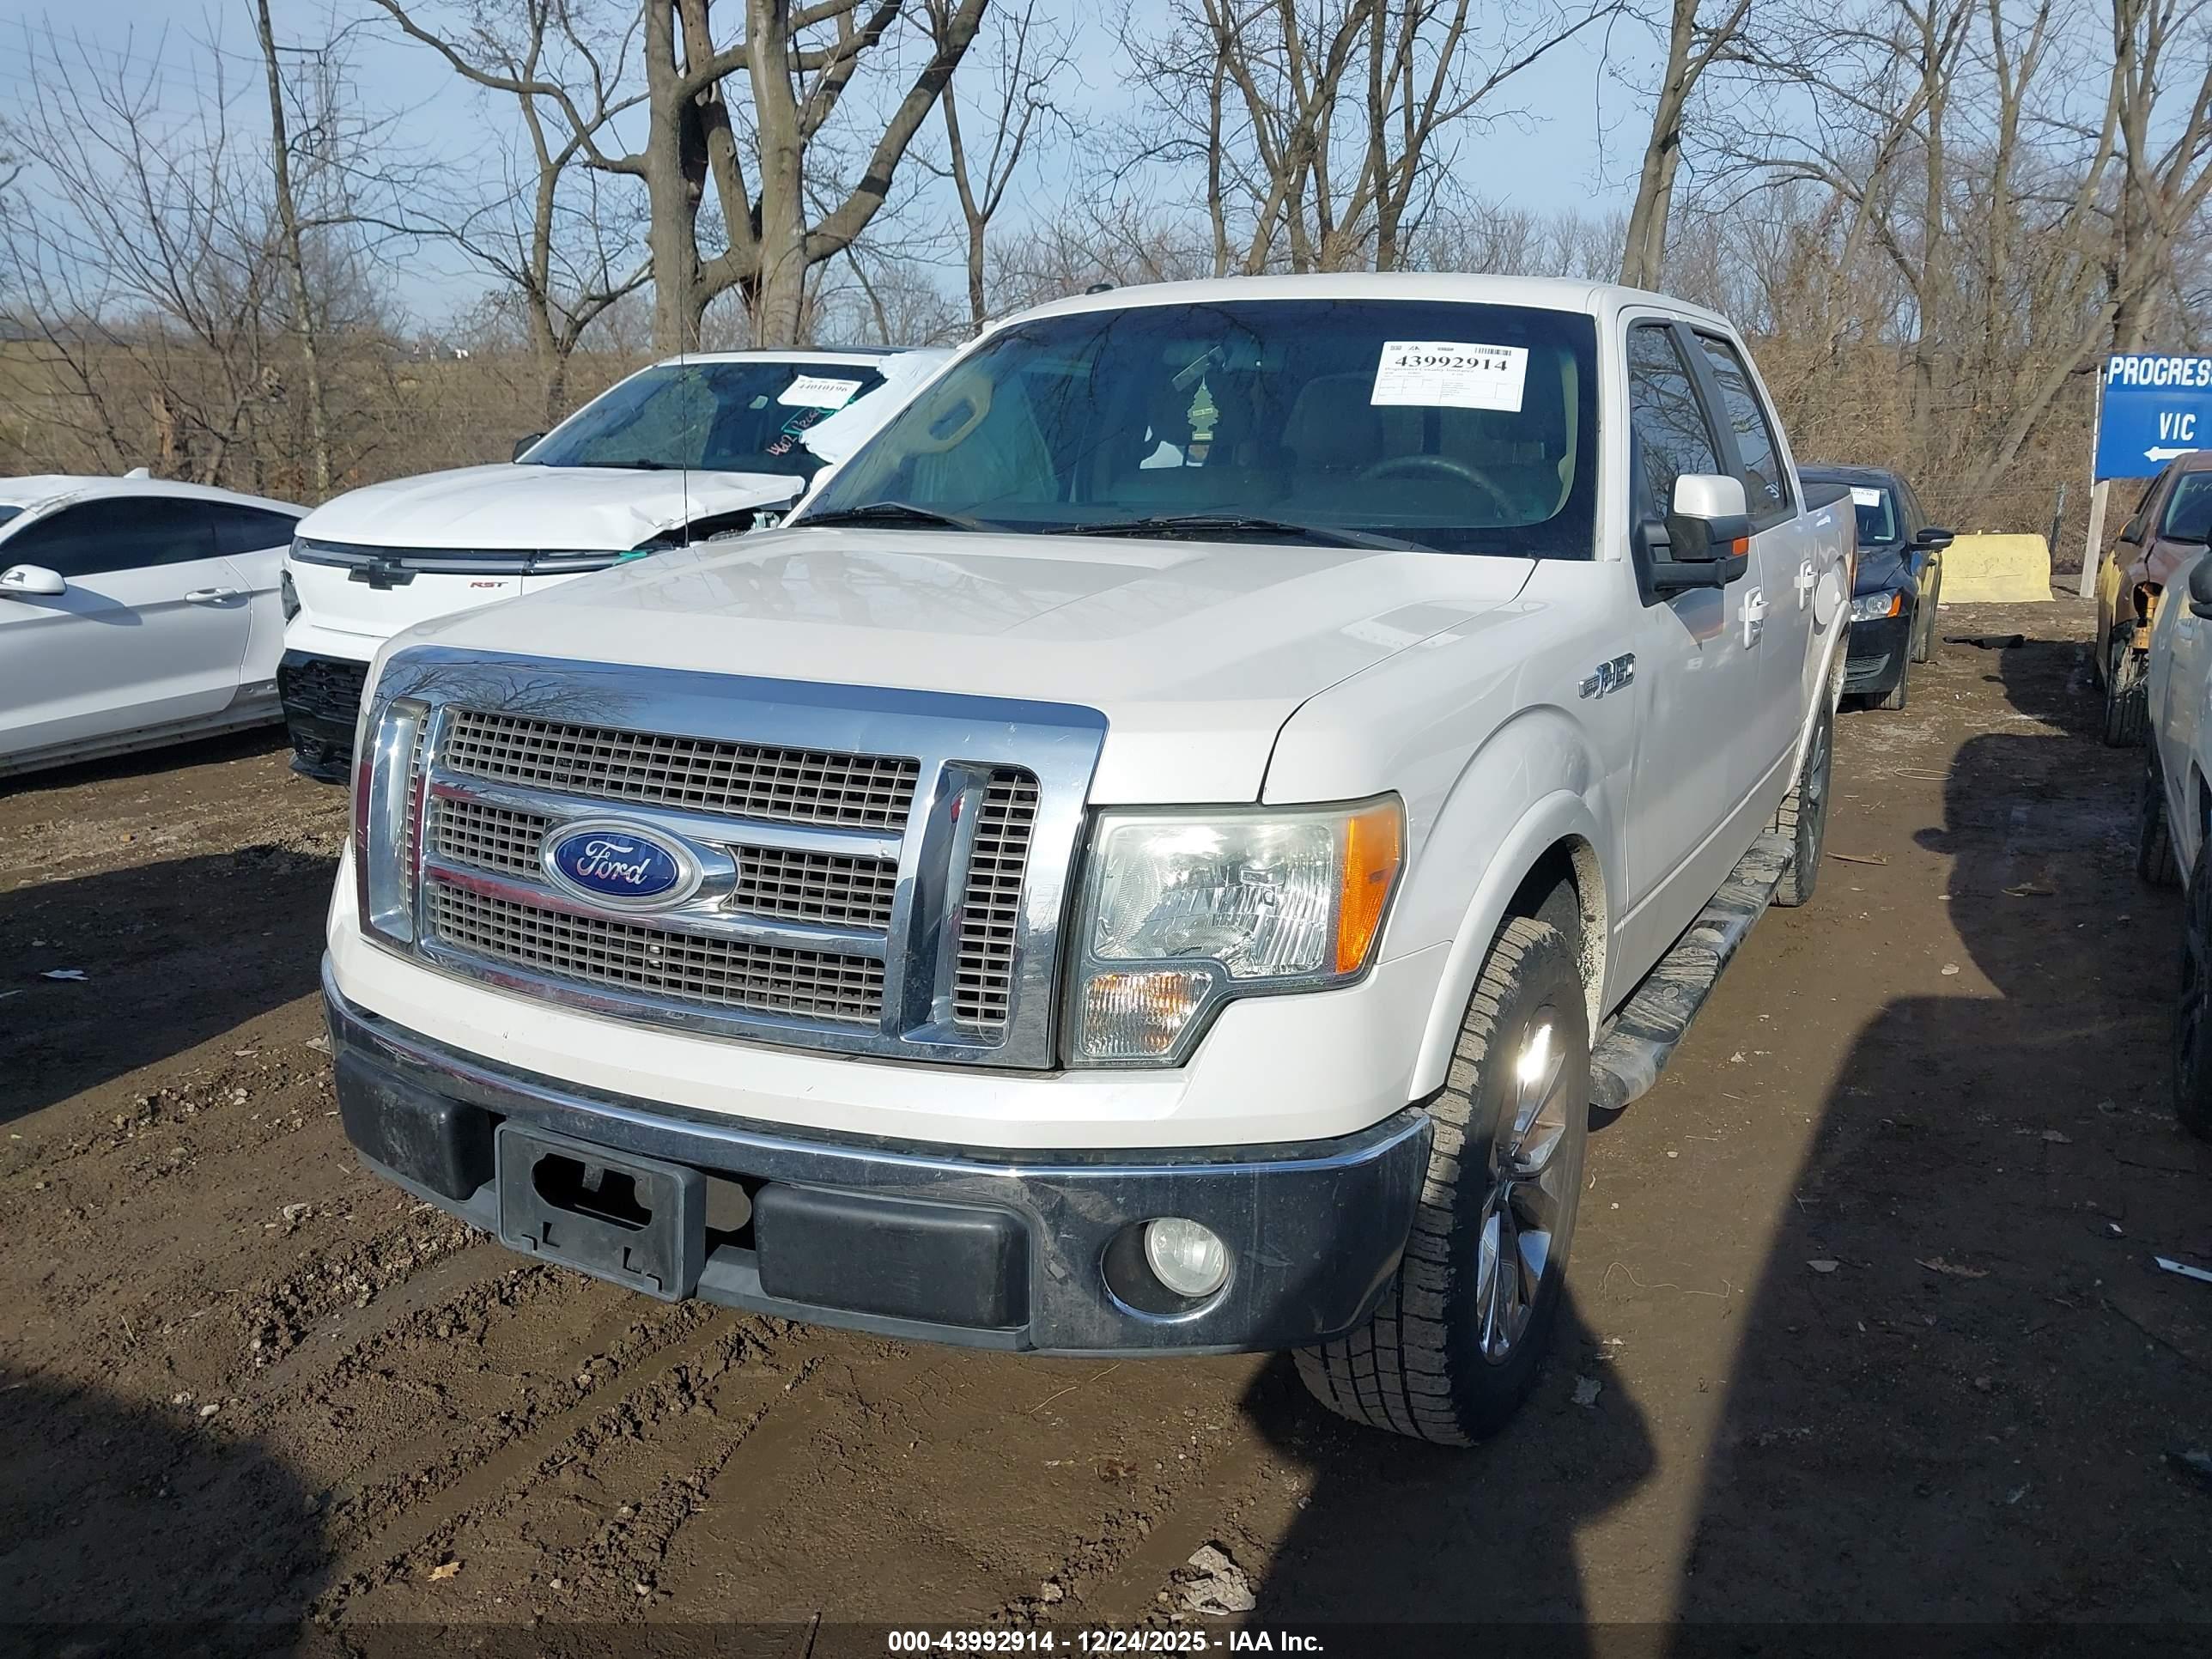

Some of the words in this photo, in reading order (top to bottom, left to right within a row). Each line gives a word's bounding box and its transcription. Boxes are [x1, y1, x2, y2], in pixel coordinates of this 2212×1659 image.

[1395, 356, 1508, 371] 43992914
[2108, 356, 2212, 386] PROGRES
[2160, 412, 2197, 441] VIC
[576, 840, 652, 885] Ford
